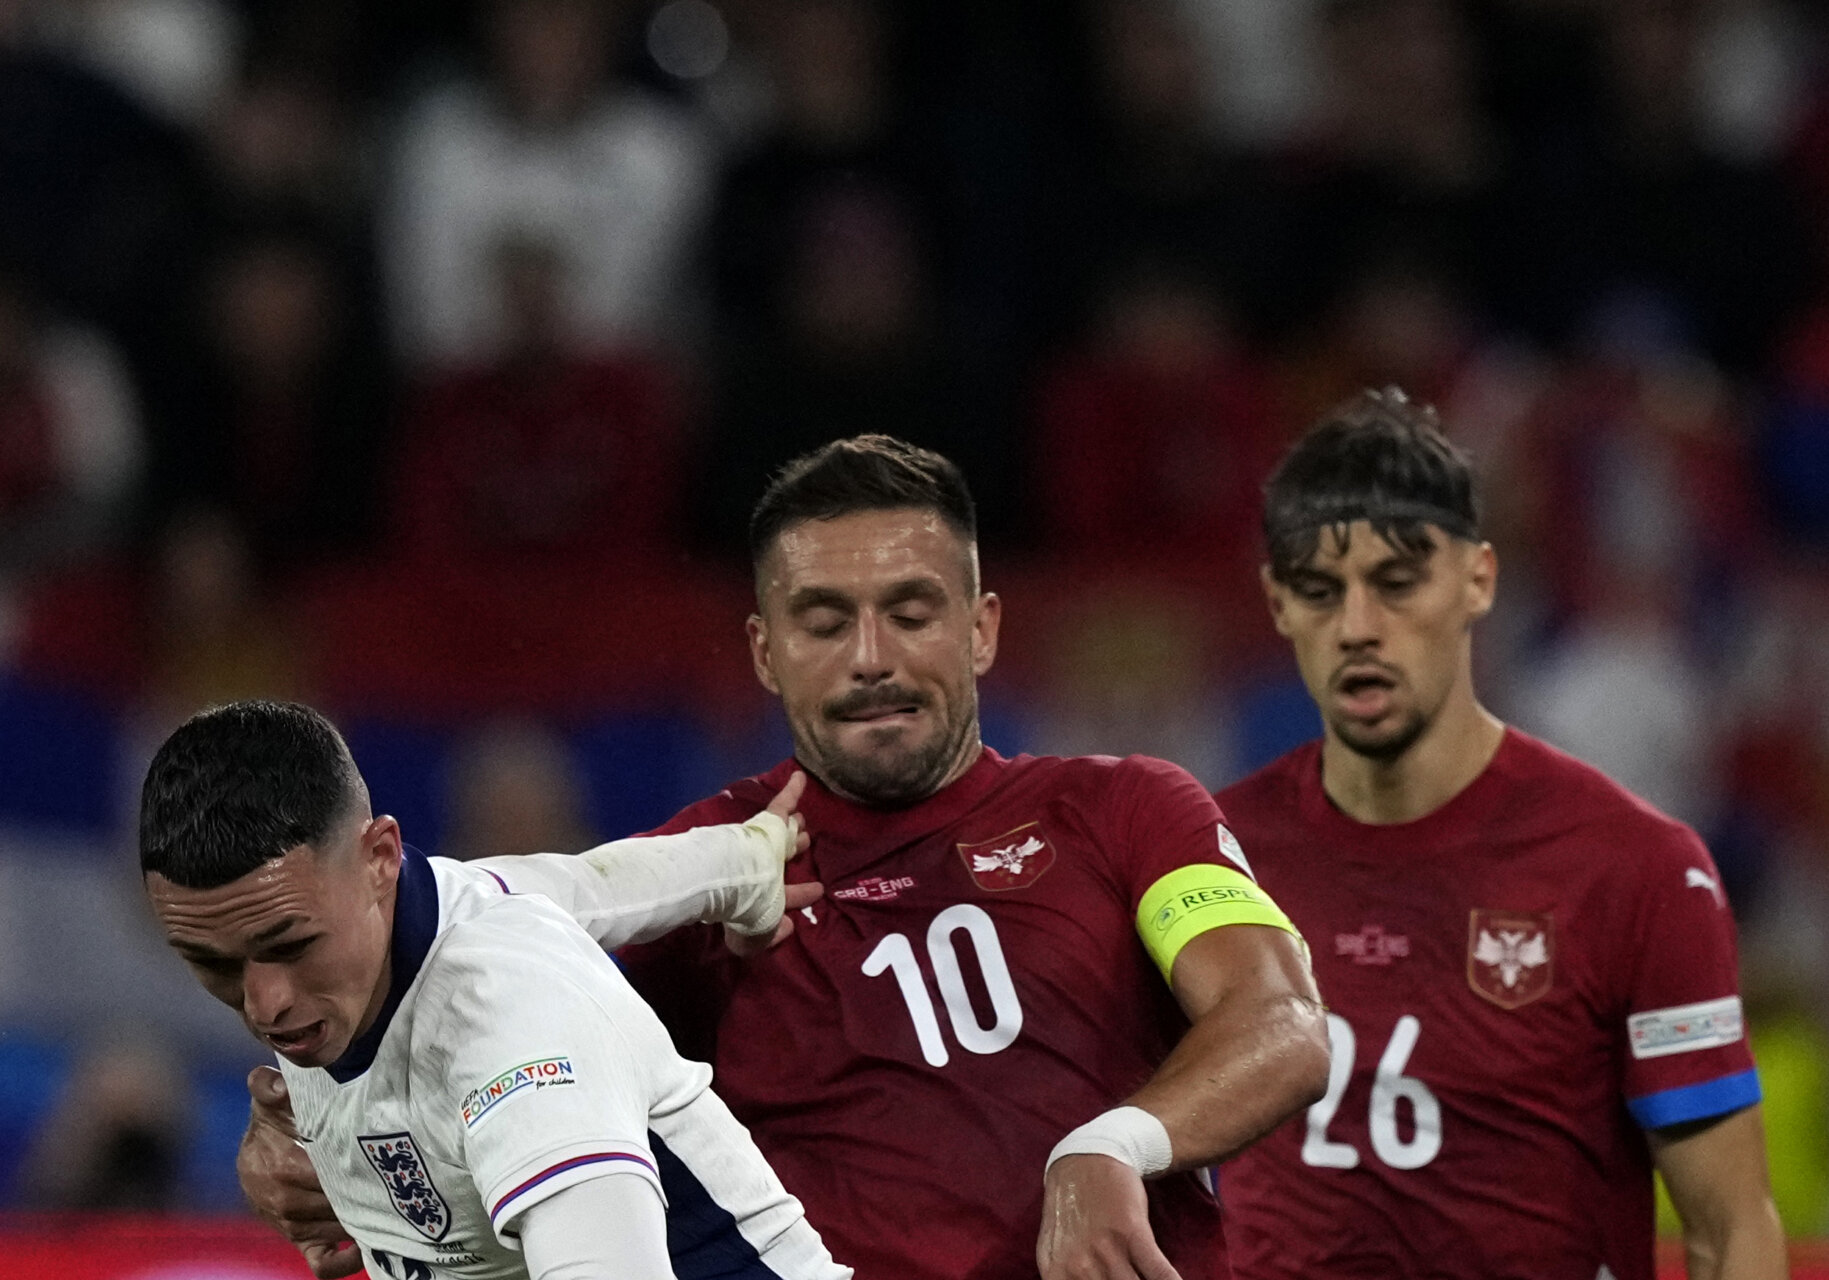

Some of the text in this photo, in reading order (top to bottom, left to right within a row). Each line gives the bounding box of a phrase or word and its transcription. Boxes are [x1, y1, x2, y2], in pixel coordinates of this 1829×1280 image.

[861, 903, 1024, 1068] 10
[463, 1061, 573, 1124] FOUNDATION
[1302, 1013, 1442, 1170] 26
